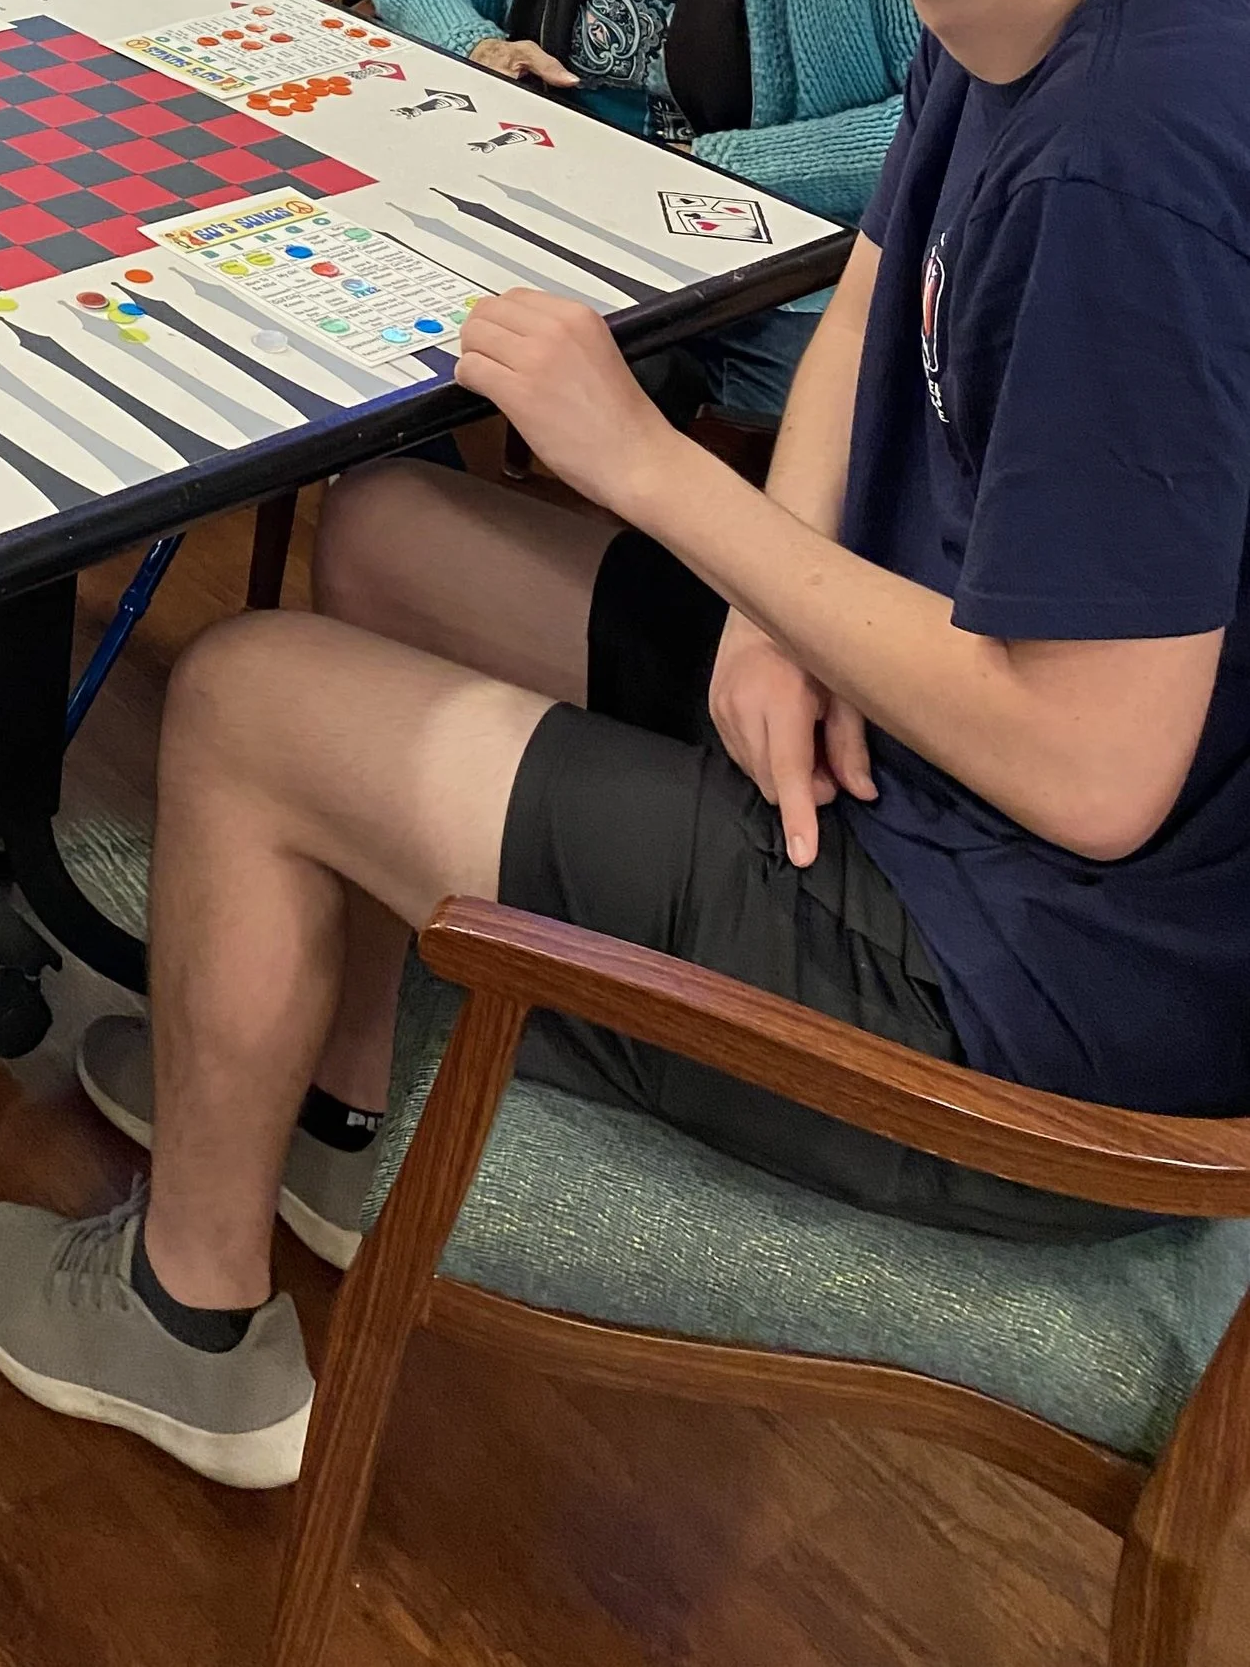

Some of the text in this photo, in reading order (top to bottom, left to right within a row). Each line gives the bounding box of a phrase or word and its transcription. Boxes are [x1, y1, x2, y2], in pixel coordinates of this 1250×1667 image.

[142, 47, 225, 81] 60'S SONGS
[193, 206, 294, 241] 60'S SONGS
[346, 1110, 382, 1132] PU
